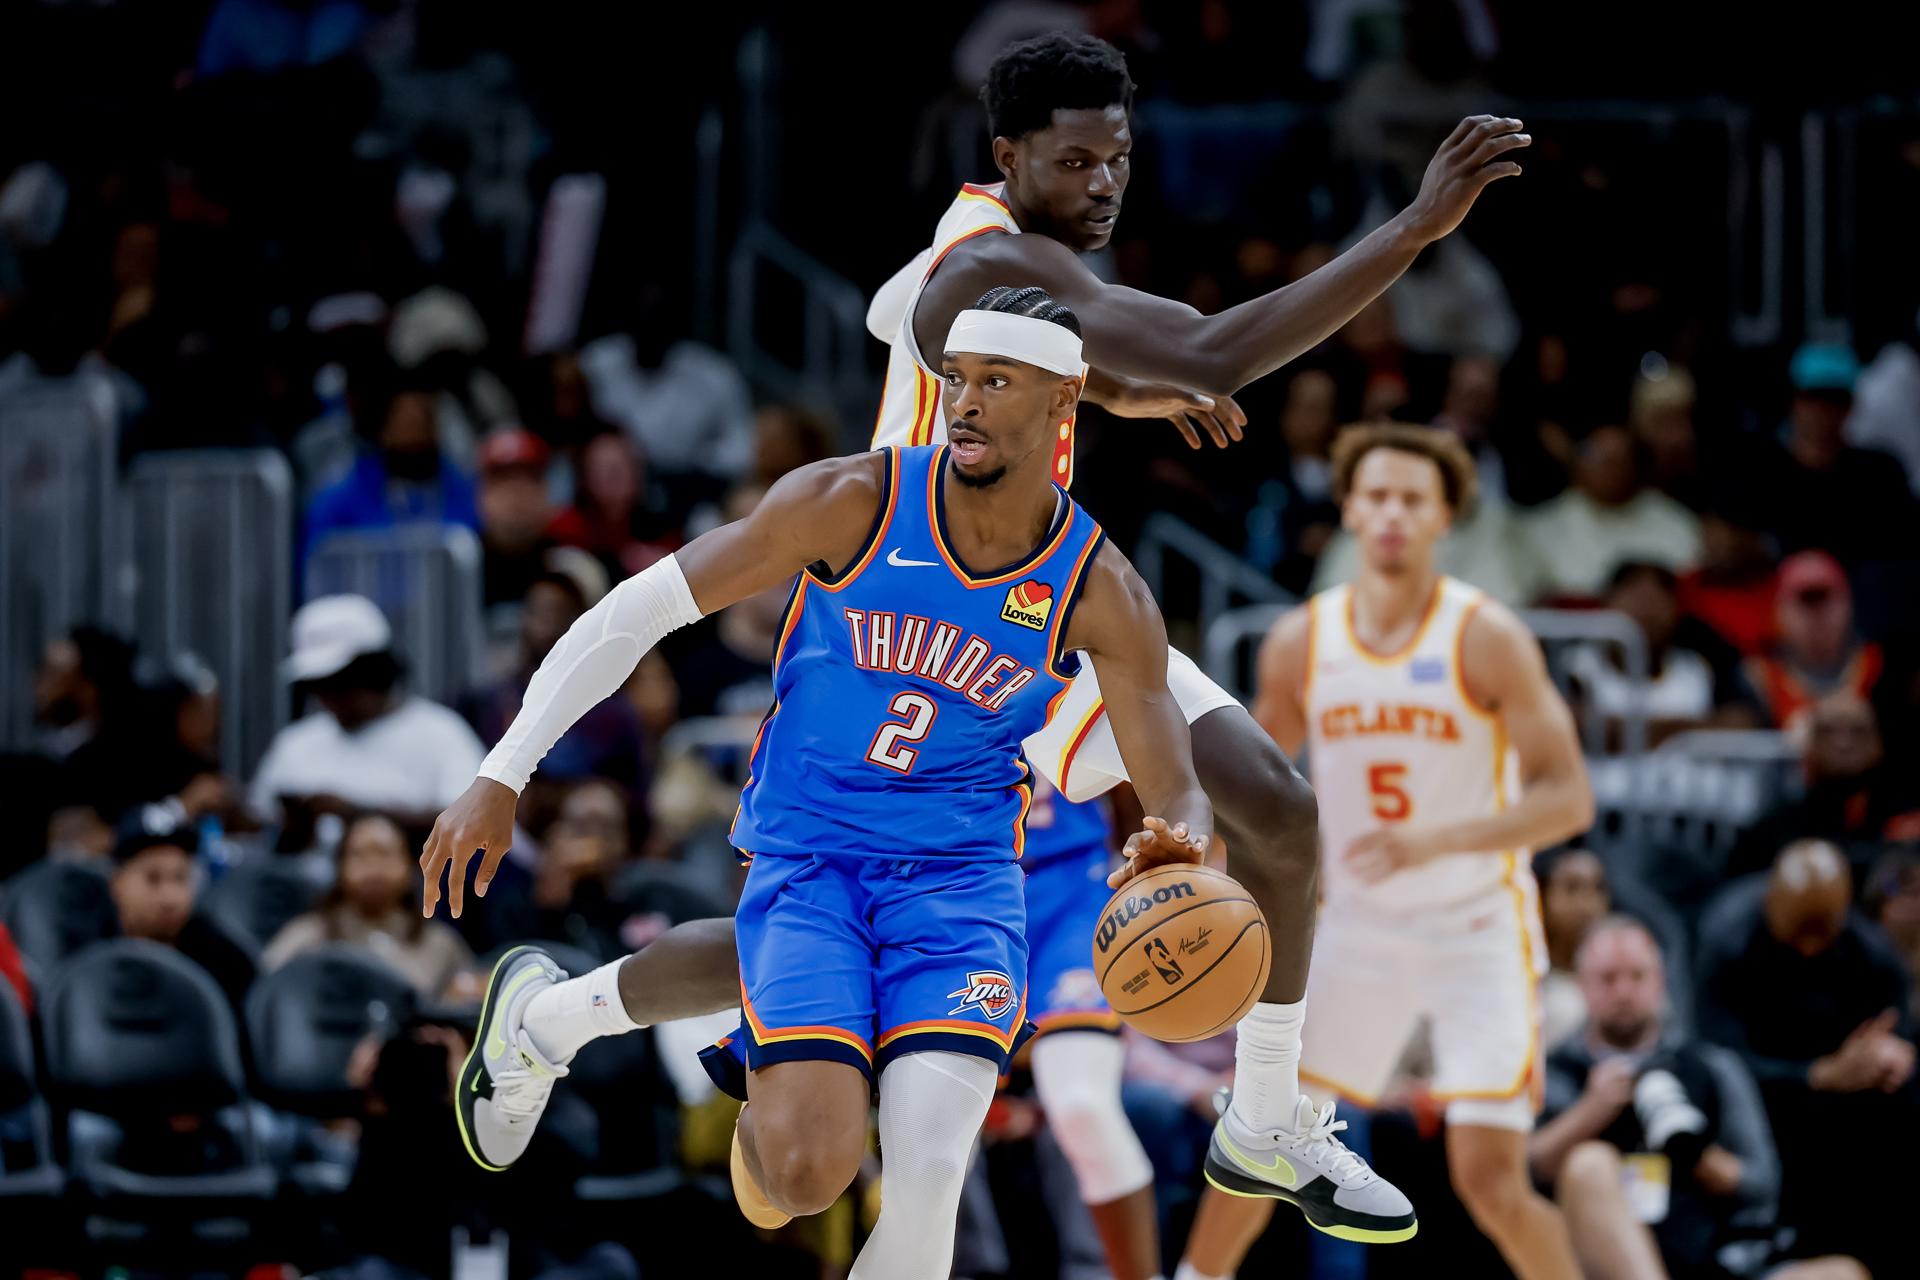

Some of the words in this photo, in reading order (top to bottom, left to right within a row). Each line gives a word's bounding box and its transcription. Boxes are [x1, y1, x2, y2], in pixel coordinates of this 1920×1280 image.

[844, 607, 1036, 713] THUNDER
[865, 691, 938, 774] 2
[1321, 704, 1461, 743] ATLANTA
[1368, 763, 1413, 821] 5
[1096, 881, 1196, 954] Wilson
[965, 983, 1009, 1003] OKC
